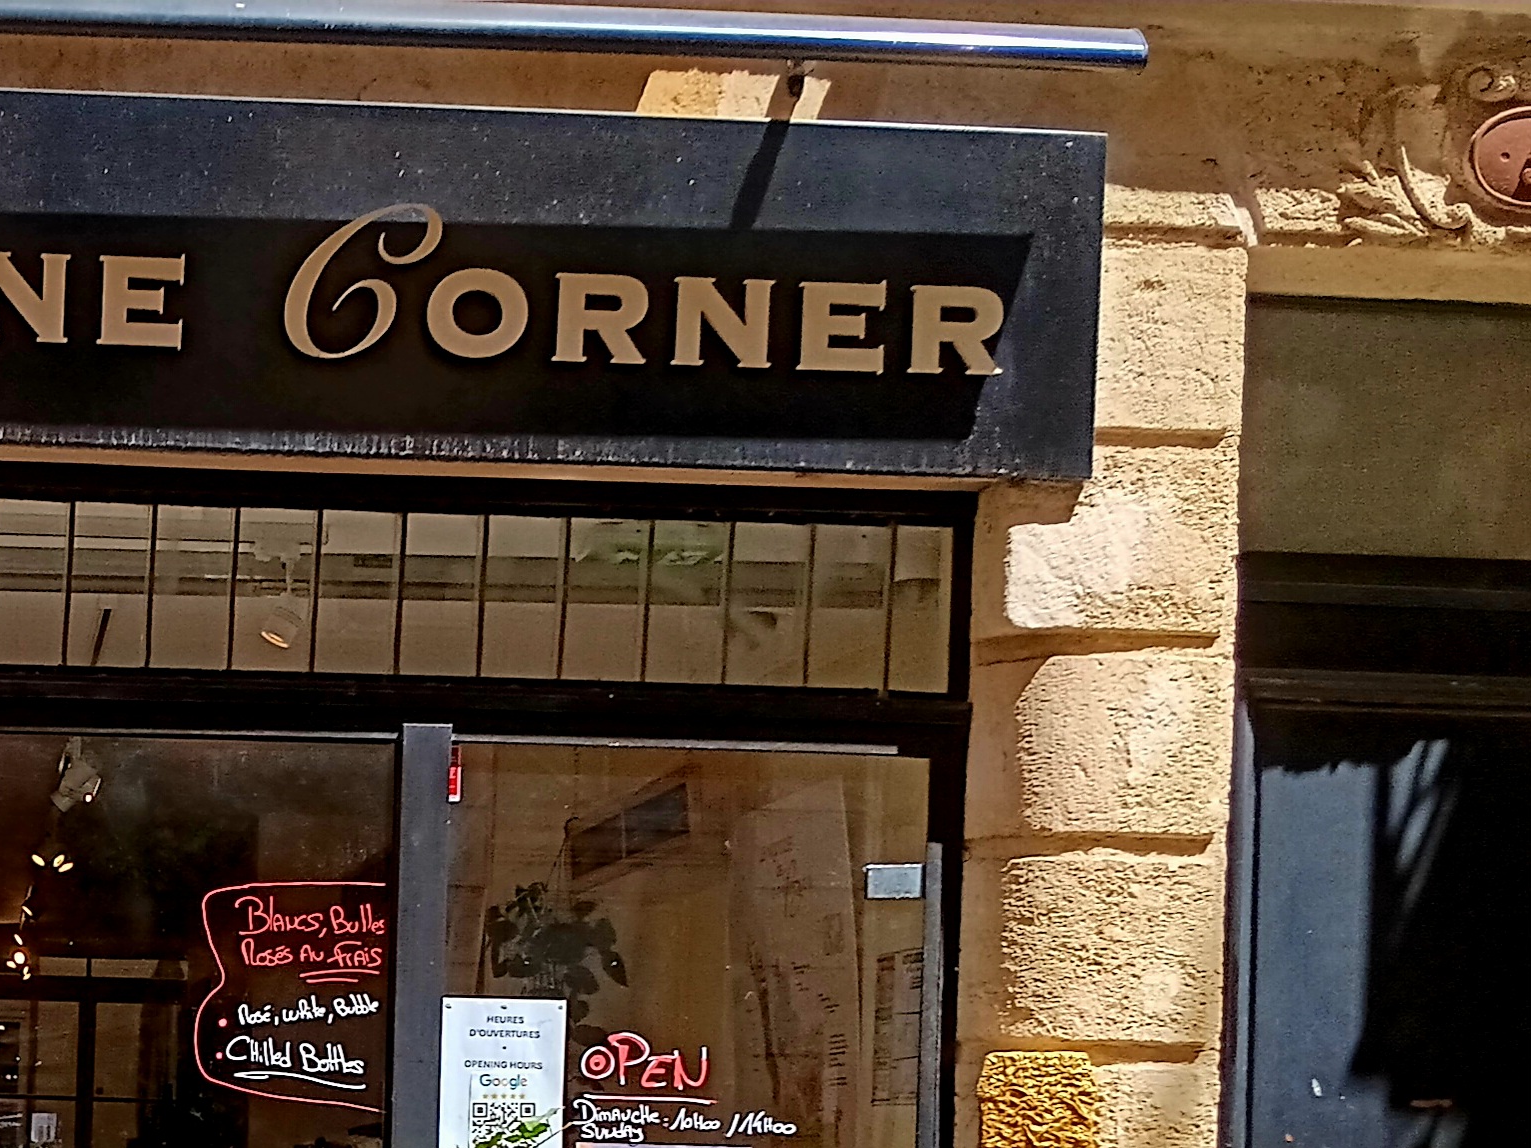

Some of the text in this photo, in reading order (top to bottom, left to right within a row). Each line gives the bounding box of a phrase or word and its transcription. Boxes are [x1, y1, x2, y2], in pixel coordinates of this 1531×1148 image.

[282, 202, 1006, 376] CORNER
[486, 1015, 525, 1024] HEURES
[469, 1028, 541, 1039] D'OUVERTURES
[299, 1042, 365, 1076] Bottles
[464, 1059, 543, 1070] OPENING HOURS
[580, 1031, 709, 1092] OPEN
[479, 1073, 528, 1090] Google
